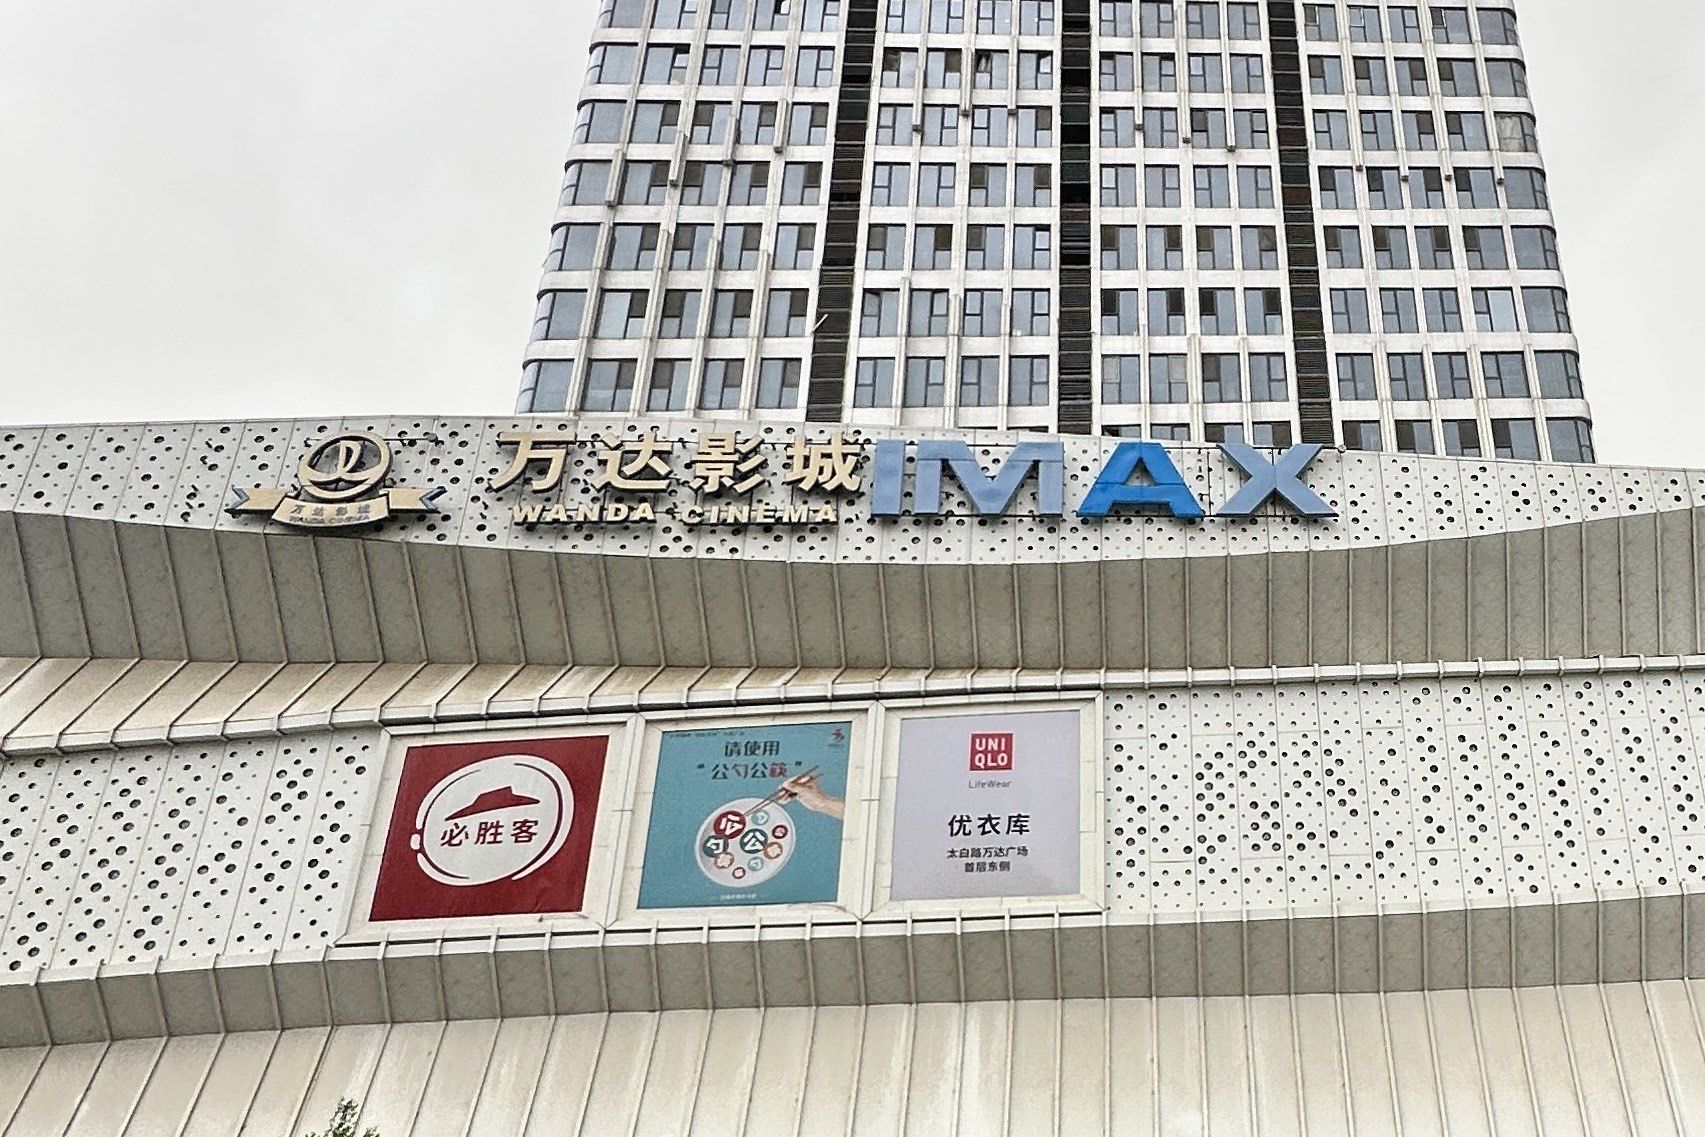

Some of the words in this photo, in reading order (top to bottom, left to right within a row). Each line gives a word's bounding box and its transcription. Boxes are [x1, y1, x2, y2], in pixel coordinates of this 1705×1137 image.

[491, 430, 862, 493] 万达影城
[871, 440, 1338, 518] IMAX
[514, 503, 655, 523] WANDA
[683, 505, 837, 524] CINEMA
[724, 740, 780, 757] 请使用
[440, 818, 539, 847] 必胜客
[948, 813, 1030, 837] 优衣库
[946, 845, 1029, 859] 太白路万达广场
